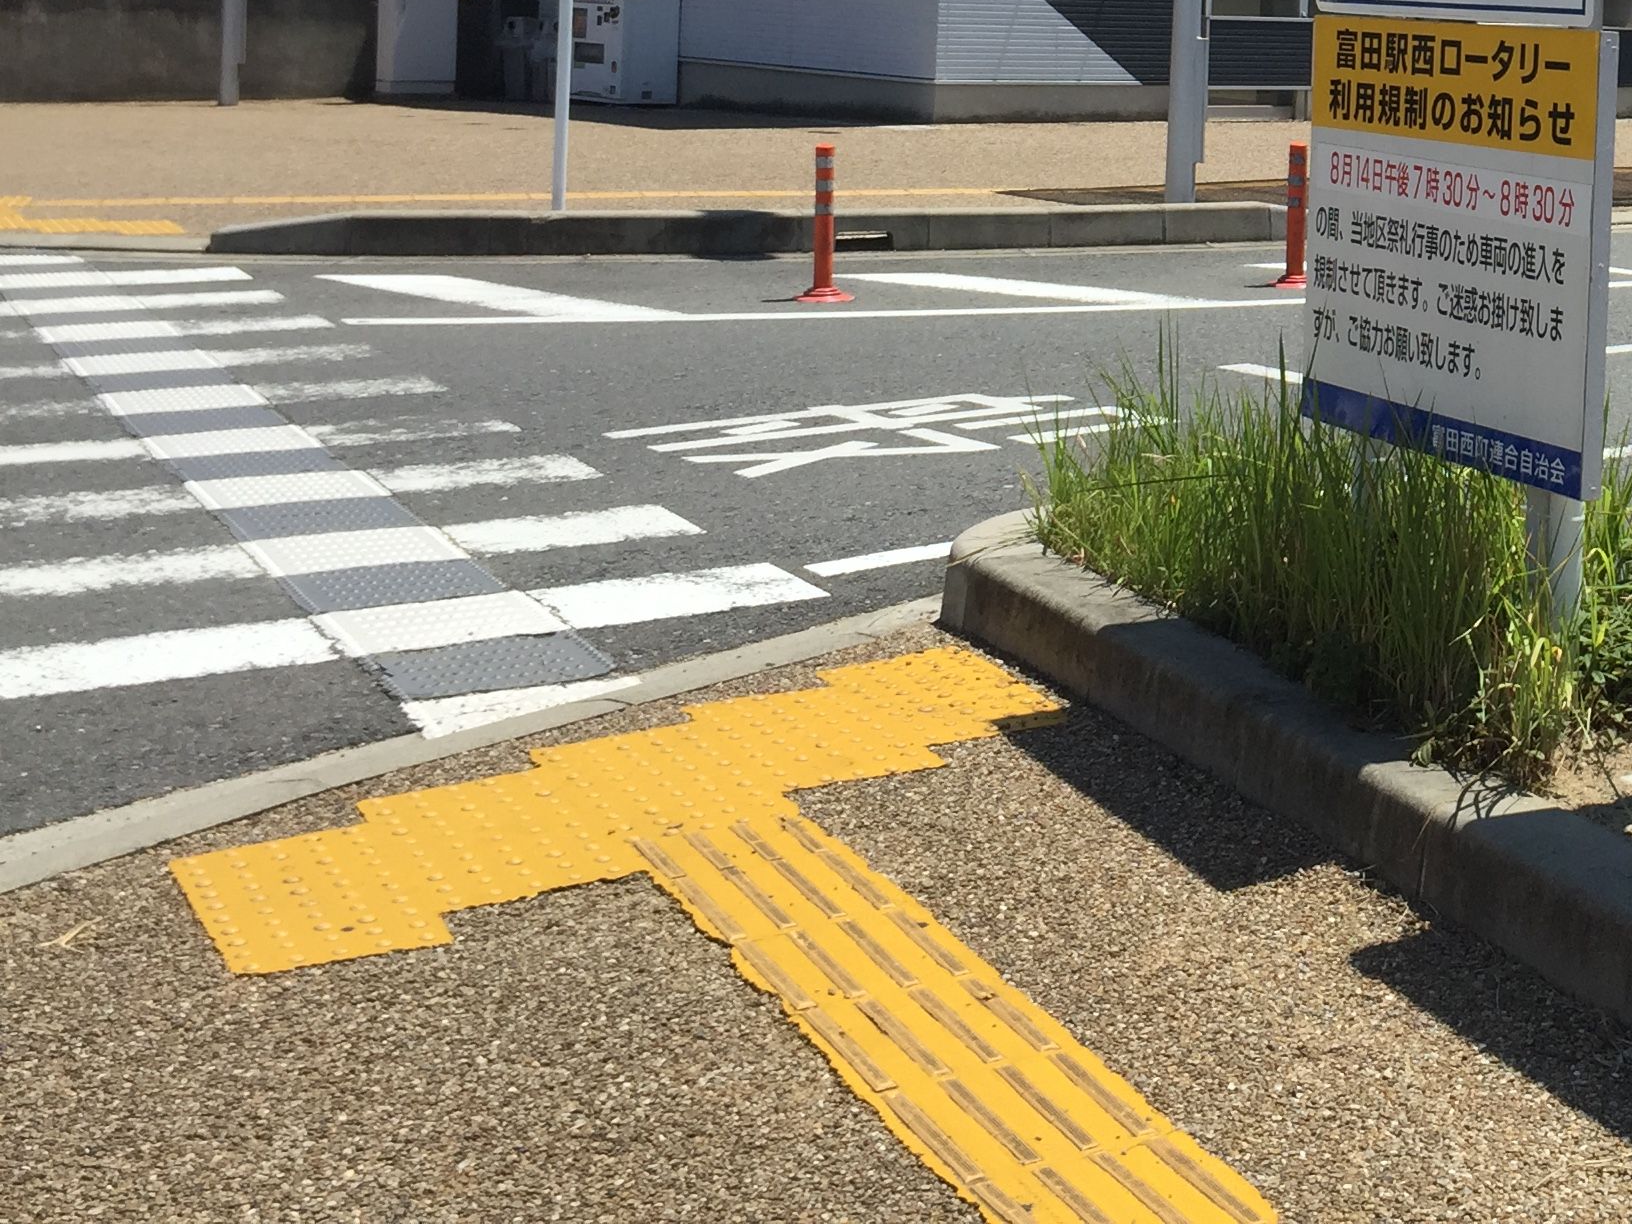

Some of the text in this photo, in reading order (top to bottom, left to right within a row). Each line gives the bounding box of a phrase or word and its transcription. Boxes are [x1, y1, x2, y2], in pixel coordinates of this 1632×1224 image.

[1335, 28, 1572, 84] 富田駅西ロータリー
[1328, 79, 1575, 146] 利用規制のお知らせ
[1316, 204, 1566, 286] の間、当地区祭礼行事のため車両の進入を
[1313, 255, 1564, 342] 規制させて頂きます。ご迷惑お掛け致しま
[1312, 307, 1482, 380] すが、ご協力お願い致します。
